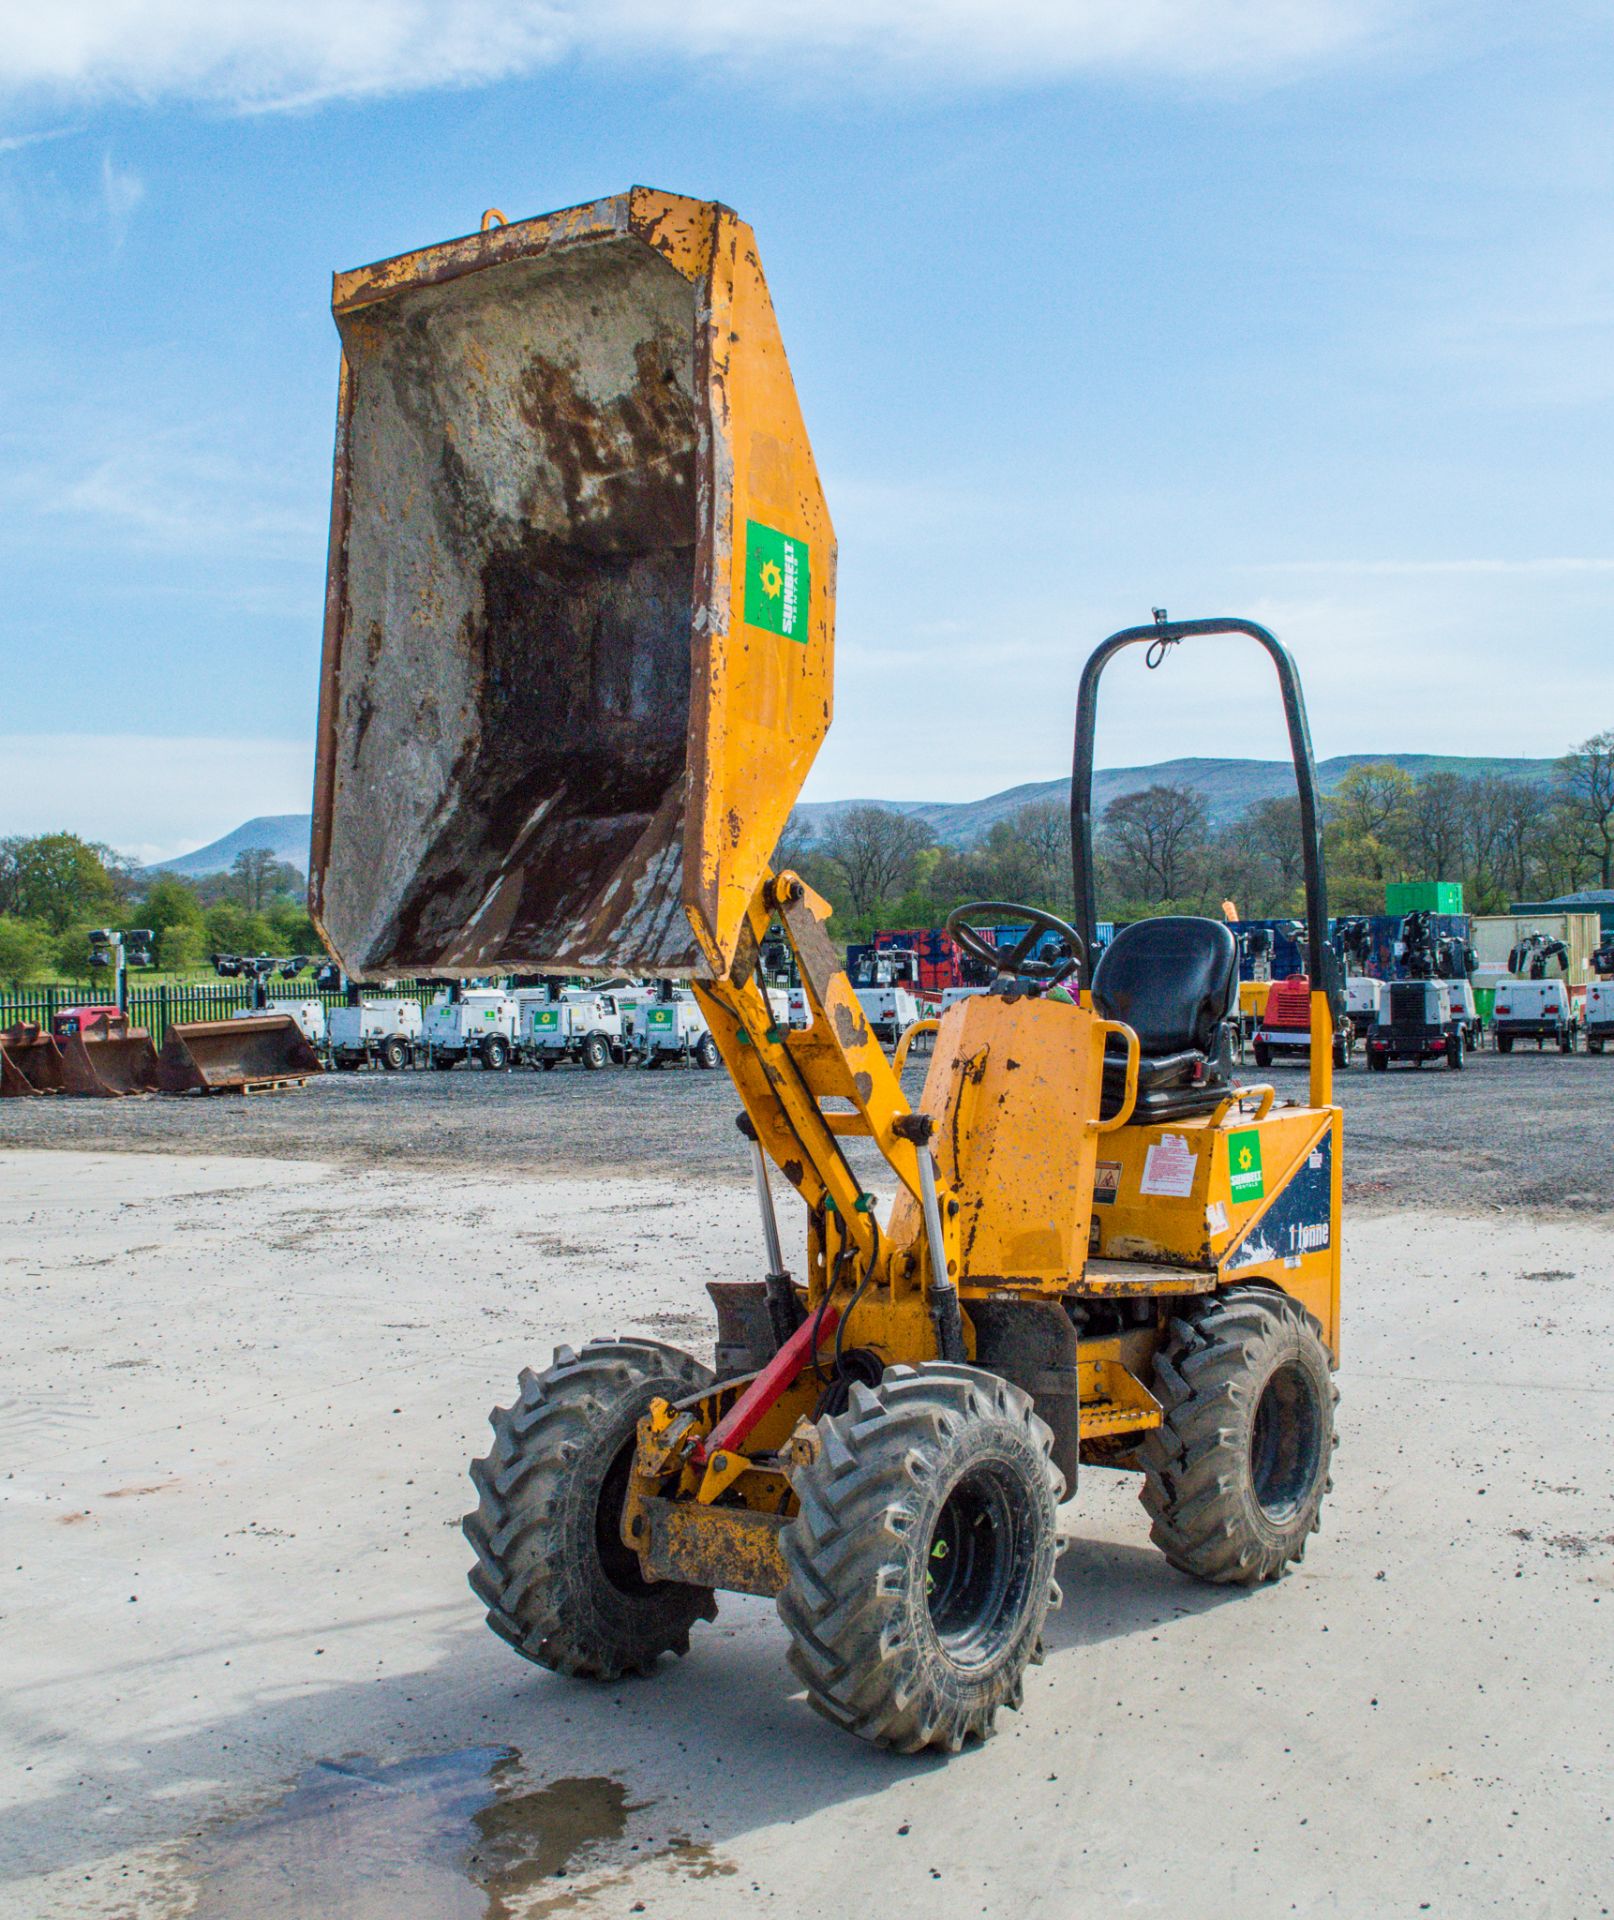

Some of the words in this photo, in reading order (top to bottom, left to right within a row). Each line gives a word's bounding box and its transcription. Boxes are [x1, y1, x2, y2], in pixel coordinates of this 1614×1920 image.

[782, 540, 794, 634] SUNBELT
[1289, 1223, 1295, 1250] 1
[1298, 1222, 1329, 1249] tonne
